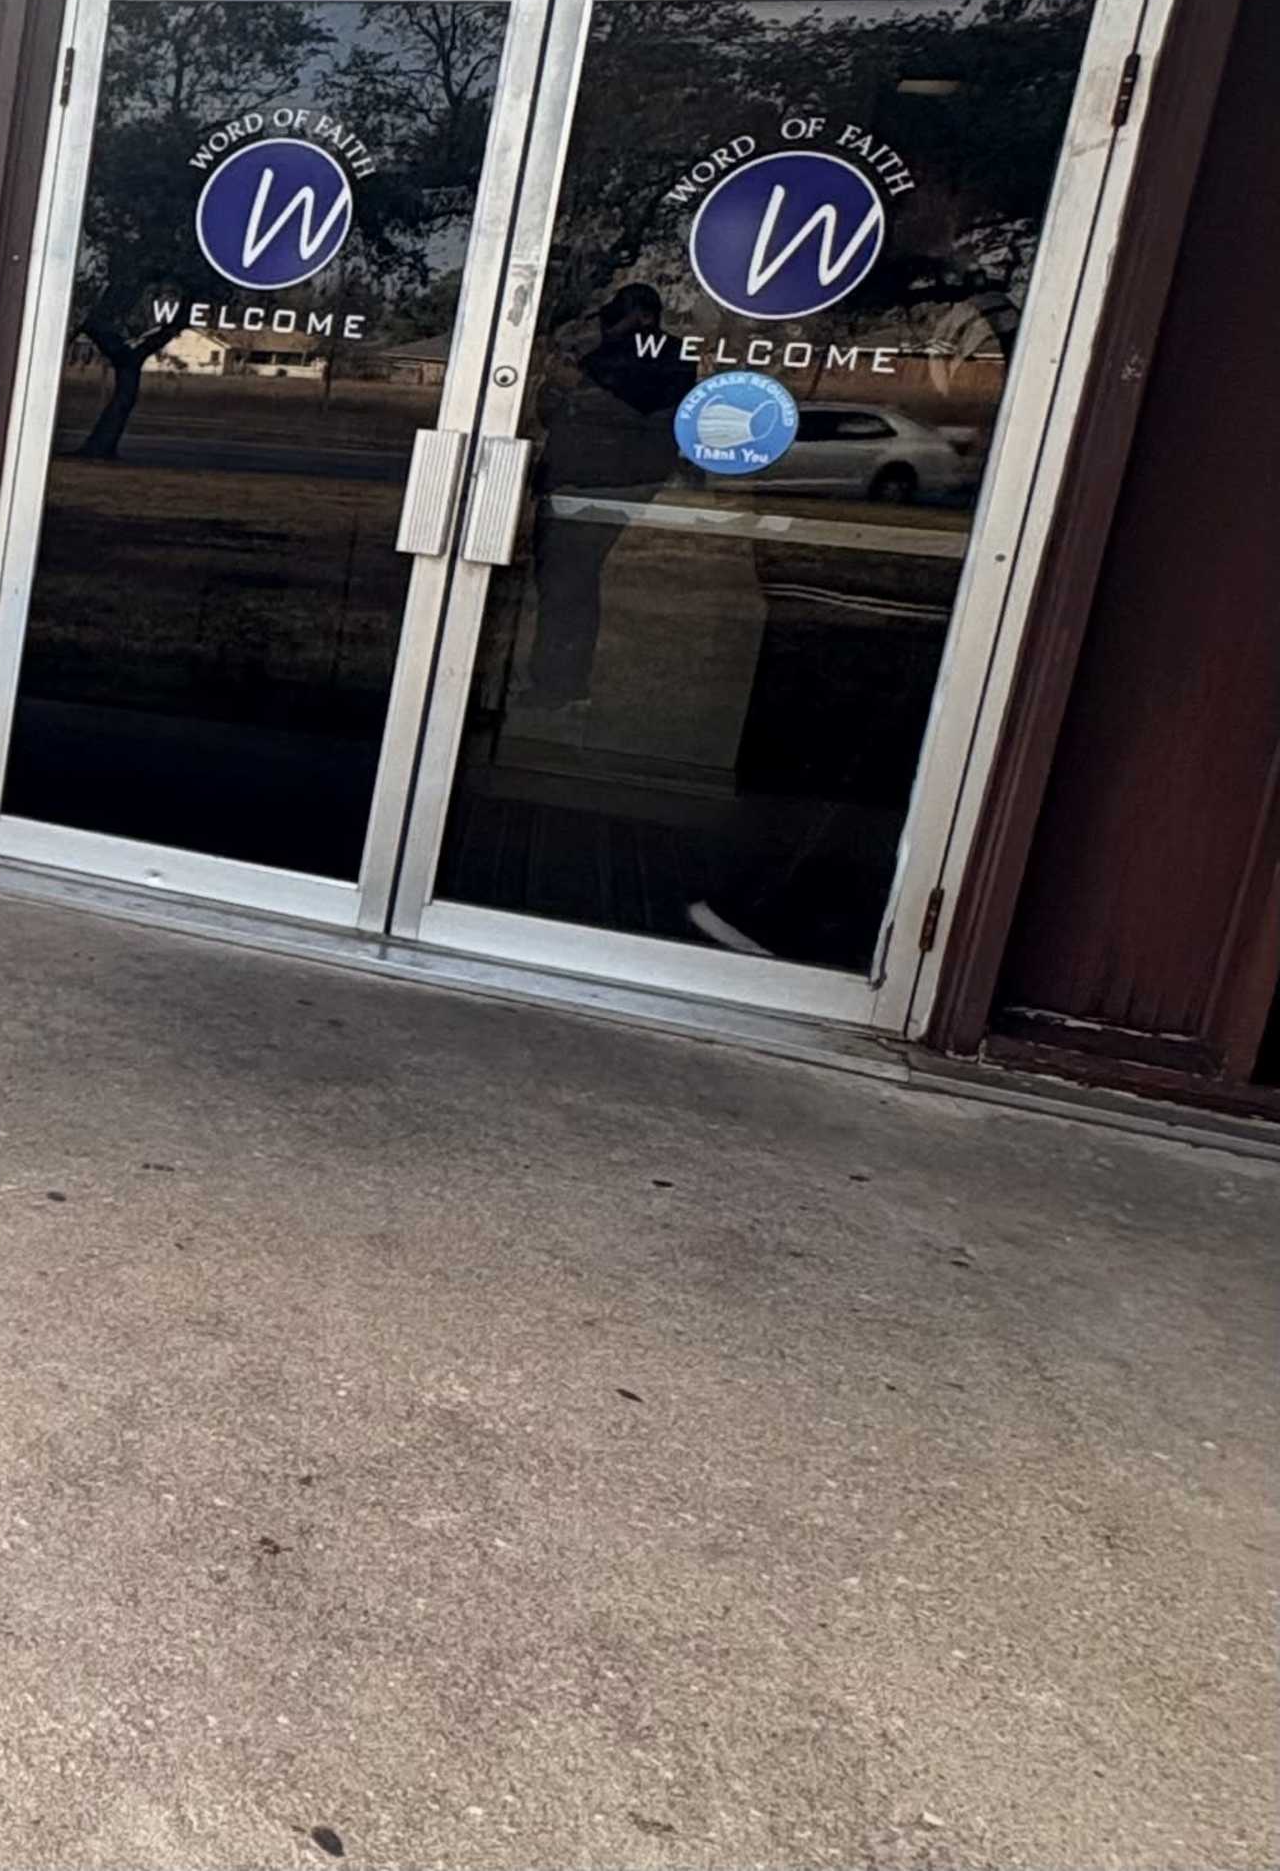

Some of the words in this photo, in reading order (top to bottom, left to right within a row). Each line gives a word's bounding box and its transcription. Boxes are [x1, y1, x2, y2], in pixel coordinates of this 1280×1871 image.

[189, 111, 264, 173] WORD
[273, 107, 311, 130] OF
[315, 114, 376, 180] FAITH
[669, 134, 757, 207] WORD
[780, 117, 827, 141] OF
[835, 124, 916, 197] FAITH
[152, 299, 366, 340] WELCOME
[634, 333, 900, 375] WELCOME
